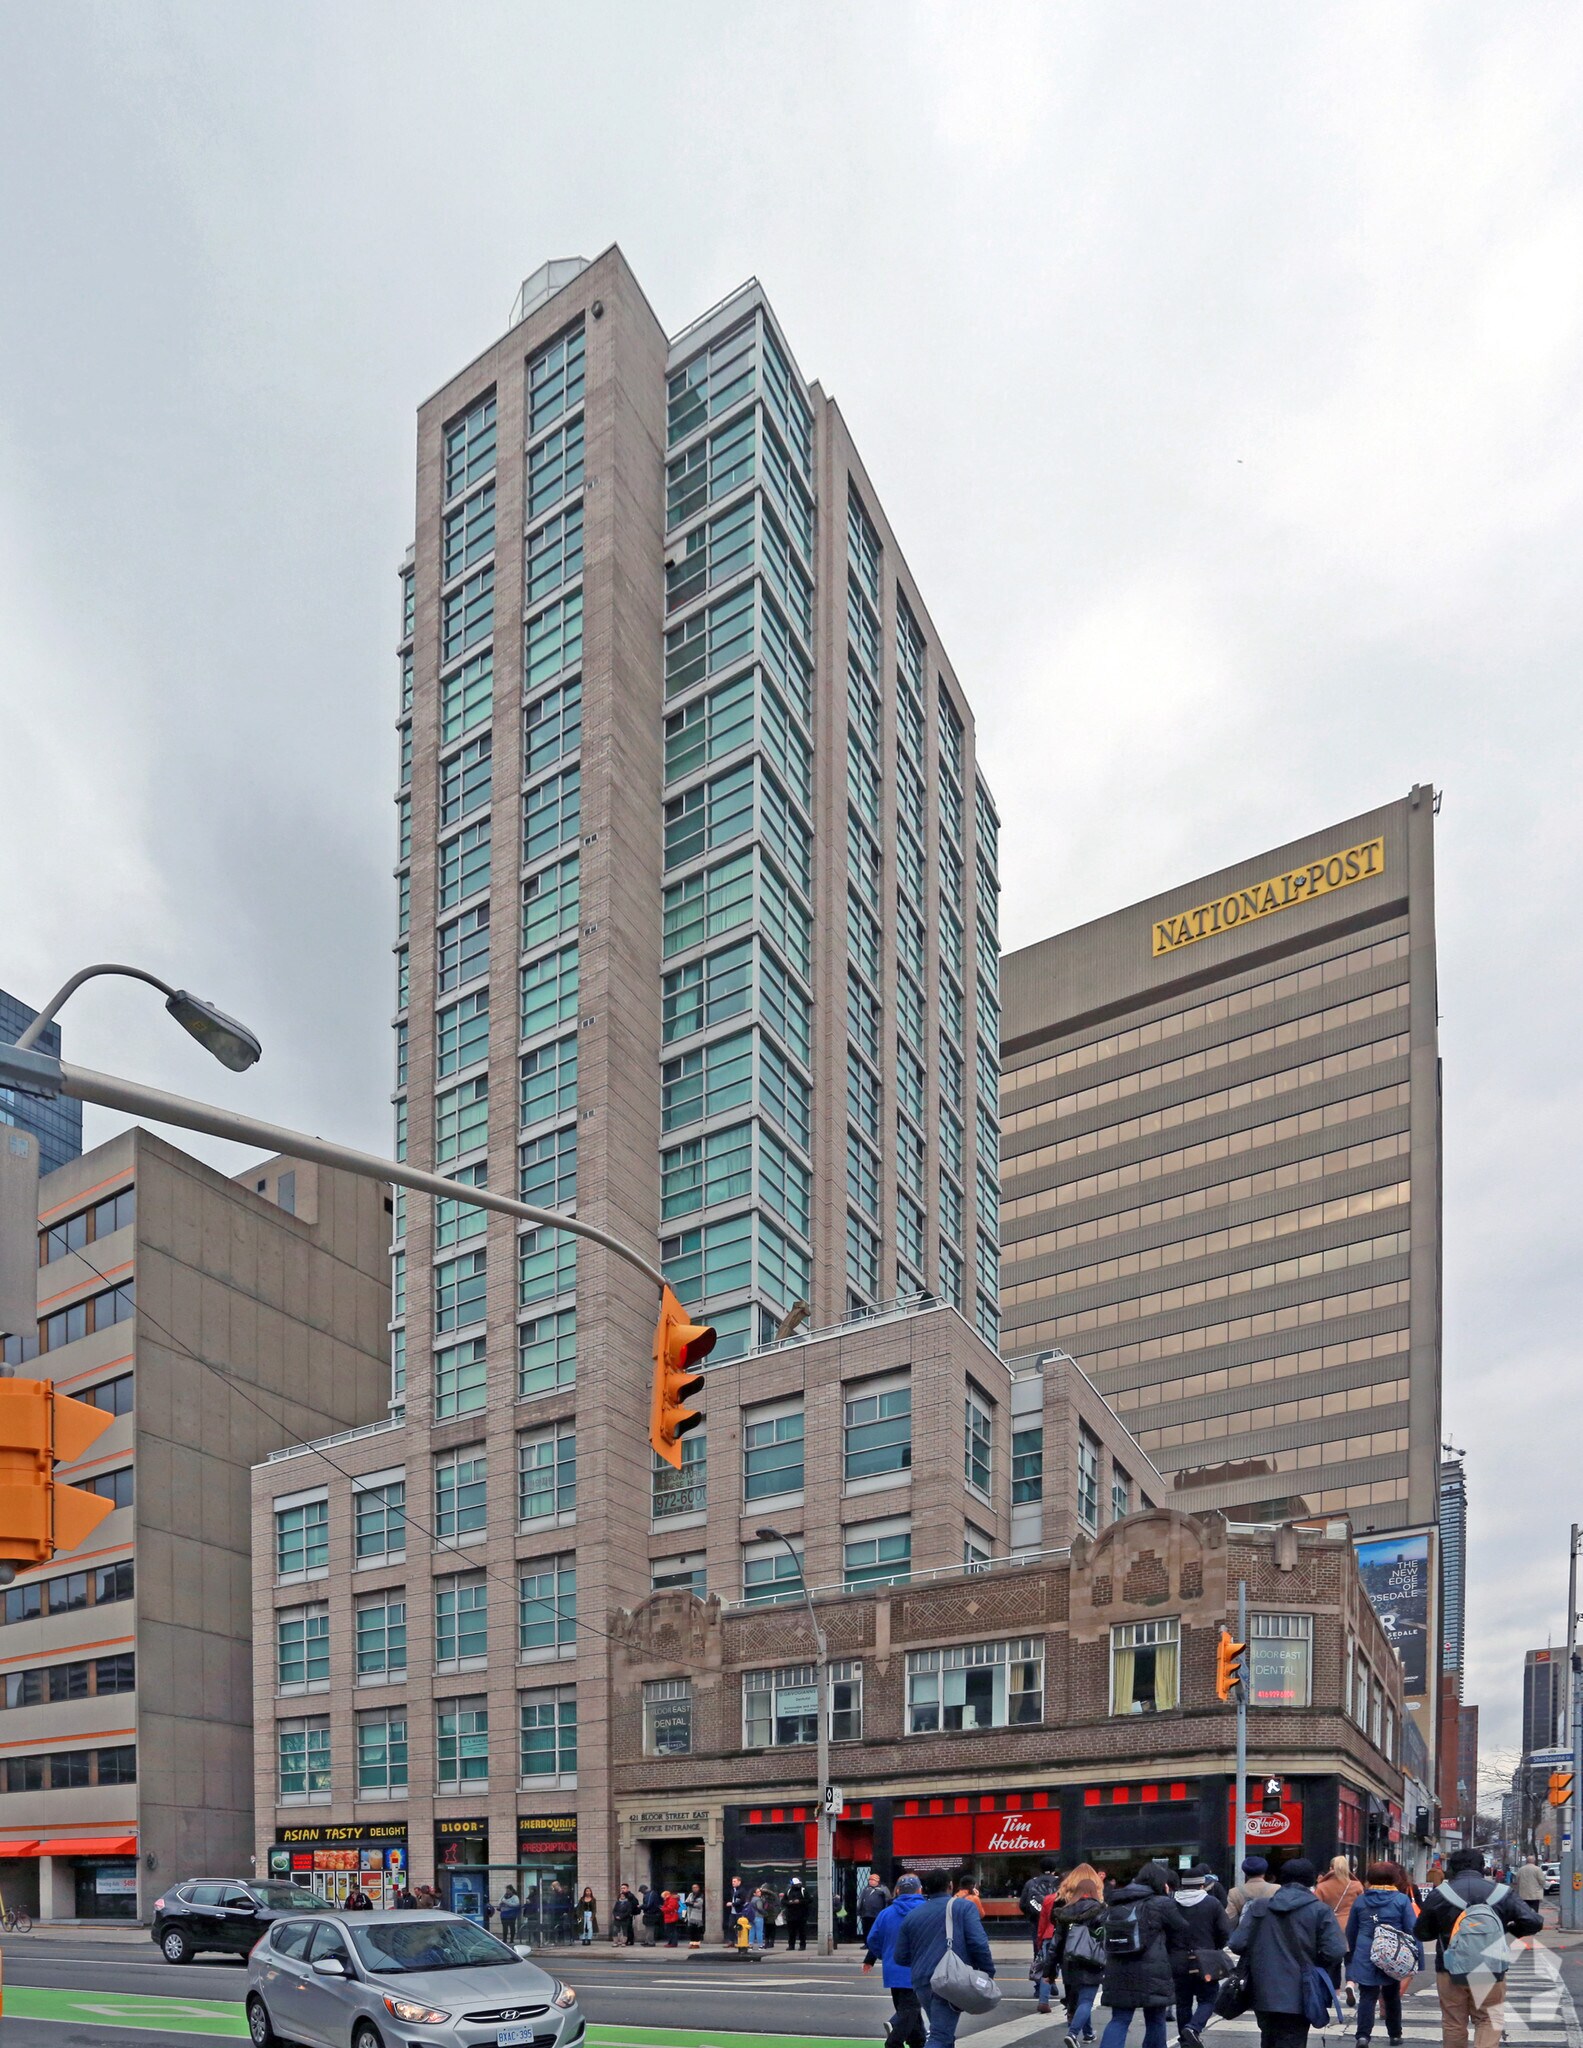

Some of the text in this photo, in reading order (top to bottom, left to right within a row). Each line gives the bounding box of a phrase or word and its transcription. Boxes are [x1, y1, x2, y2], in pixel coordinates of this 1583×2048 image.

[1157, 842, 1379, 951] NATIONAL POST
[1397, 1560, 1418, 1569] THE
[1392, 1568, 1418, 1577] NEW
[1388, 1575, 1418, 1585] EDGE
[1402, 1582, 1418, 1591] OF
[1369, 1590, 1418, 1602] OSEDALE
[1388, 1629, 1418, 1638] SEDALE
[1280, 1650, 1301, 1660] EAST
[1255, 1665, 1297, 1676] DENTAL
[652, 1705, 690, 1715] LOOR EAST
[654, 1717, 686, 1728] DENTAL
[520, 1818, 577, 1829] SHERBOURNE
[664, 1823, 700, 1831] ENTRANCE
[1002, 1814, 1031, 1832] Tim
[284, 1826, 406, 1841] ASIAN TASTY DELIGHT
[988, 1833, 1046, 1850] Hortons
